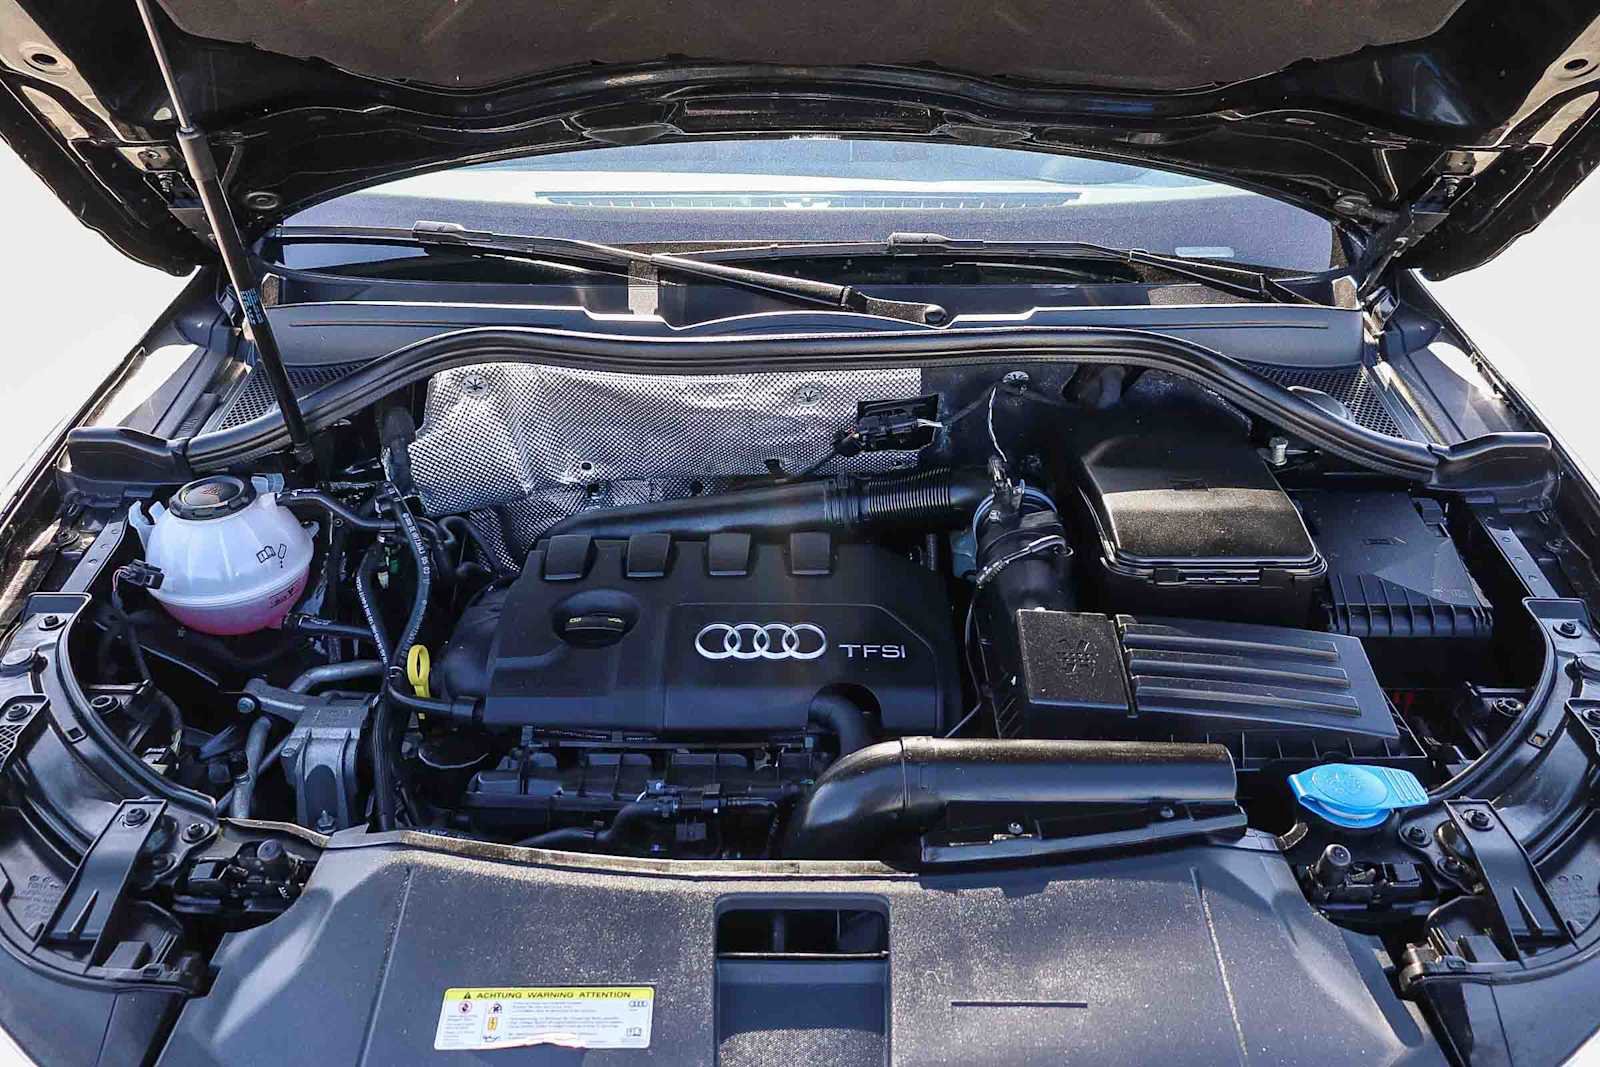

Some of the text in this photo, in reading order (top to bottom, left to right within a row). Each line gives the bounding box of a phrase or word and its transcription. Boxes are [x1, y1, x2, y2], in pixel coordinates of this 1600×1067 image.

[838, 644, 906, 658] TFSI
[476, 991, 522, 999] ACHTUNG
[527, 991, 574, 999] WARNING
